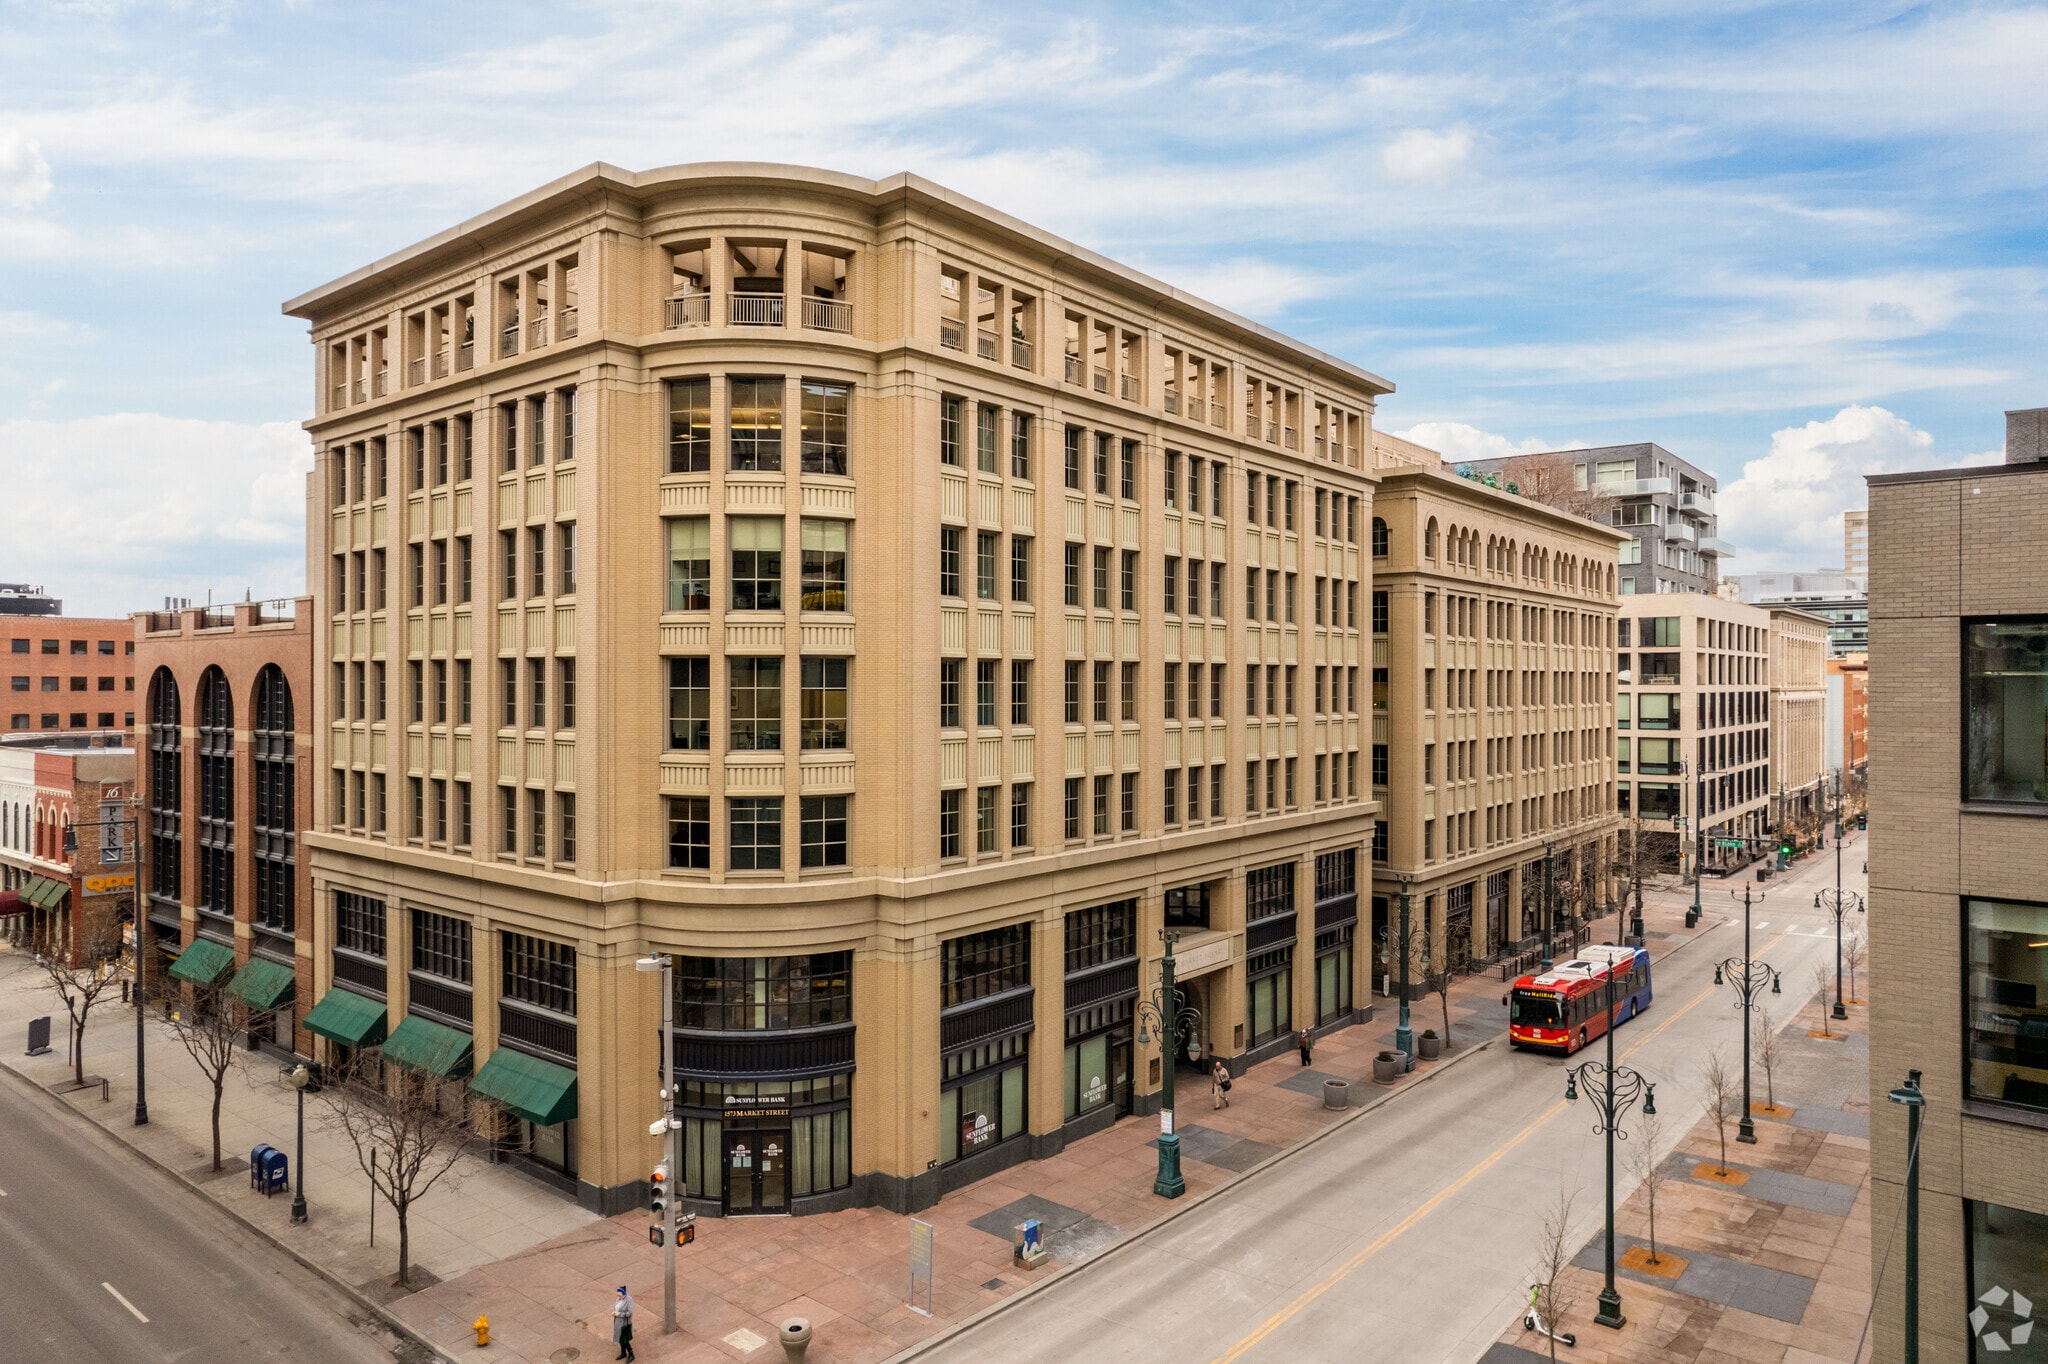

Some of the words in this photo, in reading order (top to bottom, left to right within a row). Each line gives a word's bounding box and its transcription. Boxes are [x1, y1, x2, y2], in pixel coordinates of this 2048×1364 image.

[105, 786, 119, 798] 16
[107, 806, 117, 847] PARK
[736, 1109, 765, 1117] MARKET
[765, 1108, 789, 1116] STREET
